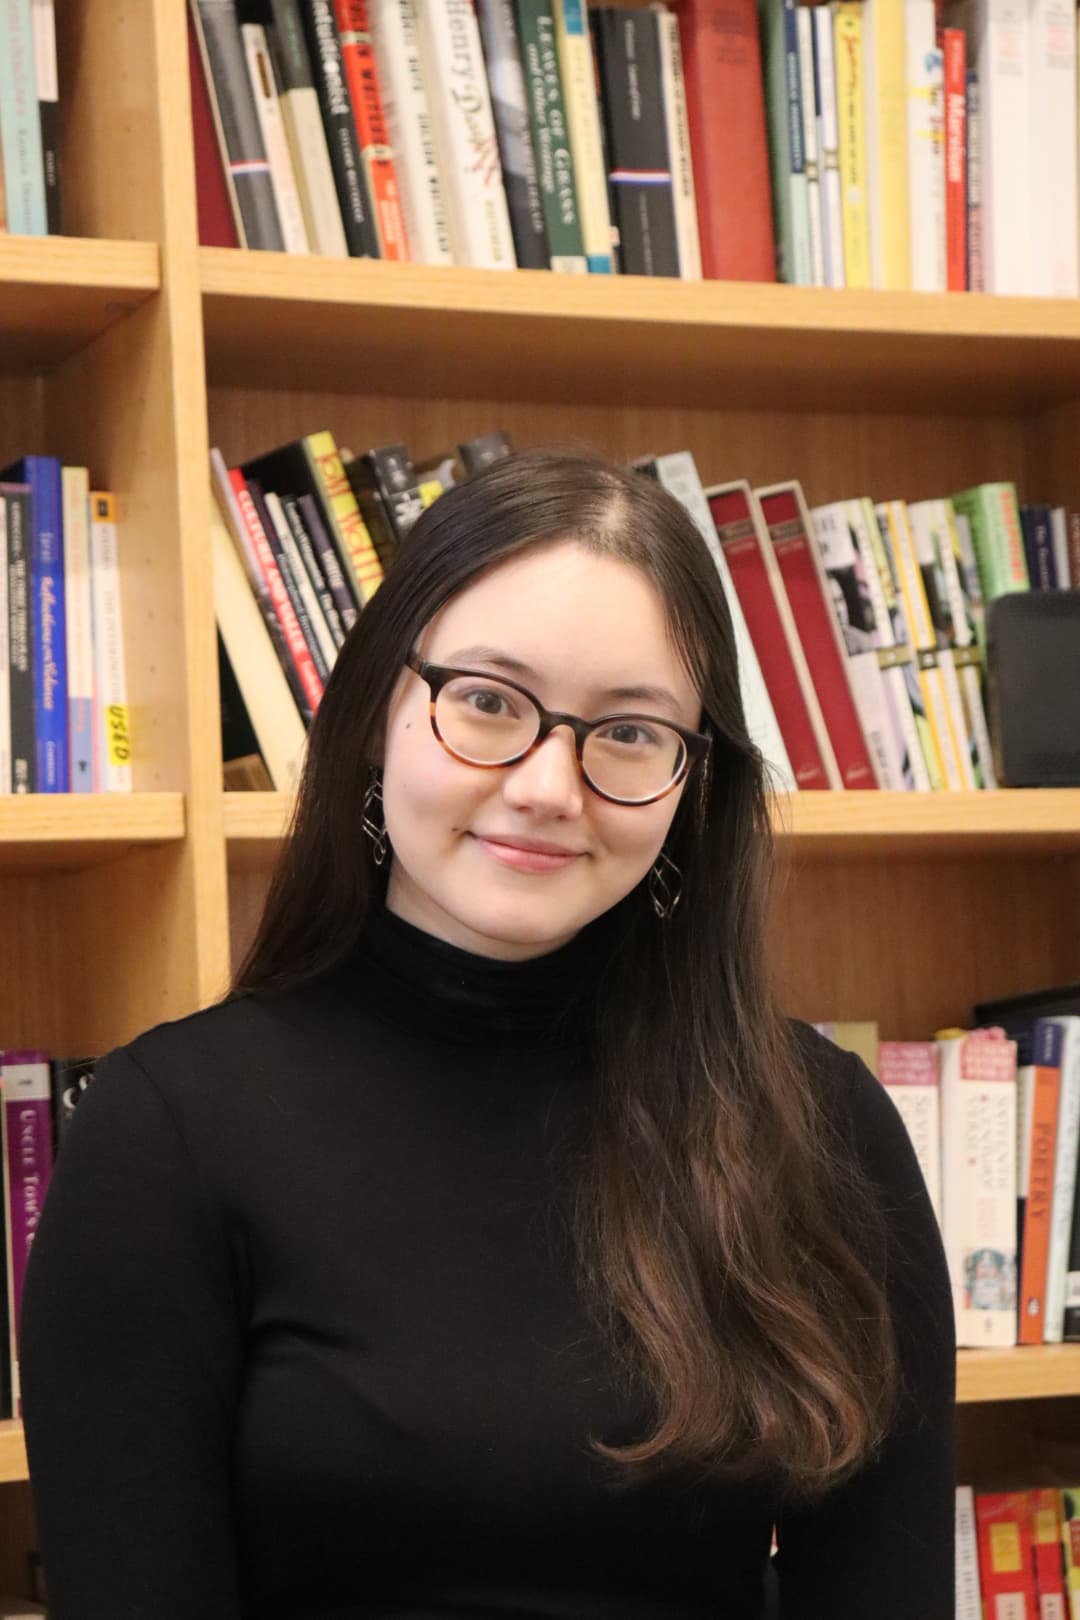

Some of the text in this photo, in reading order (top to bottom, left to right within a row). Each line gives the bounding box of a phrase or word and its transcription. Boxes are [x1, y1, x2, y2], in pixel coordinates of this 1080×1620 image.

[537, 15, 575, 224] LEAVES OF GRASS
[947, 93, 965, 182] Marxism
[238, 490, 273, 563] CULTURE
[266, 565, 287, 603] AND
[109, 706, 129, 761] USED
[19, 1109, 37, 1166] UNCLE
[1030, 1122, 1049, 1218] POETRY
[22, 1174, 42, 1227] TOM'S
